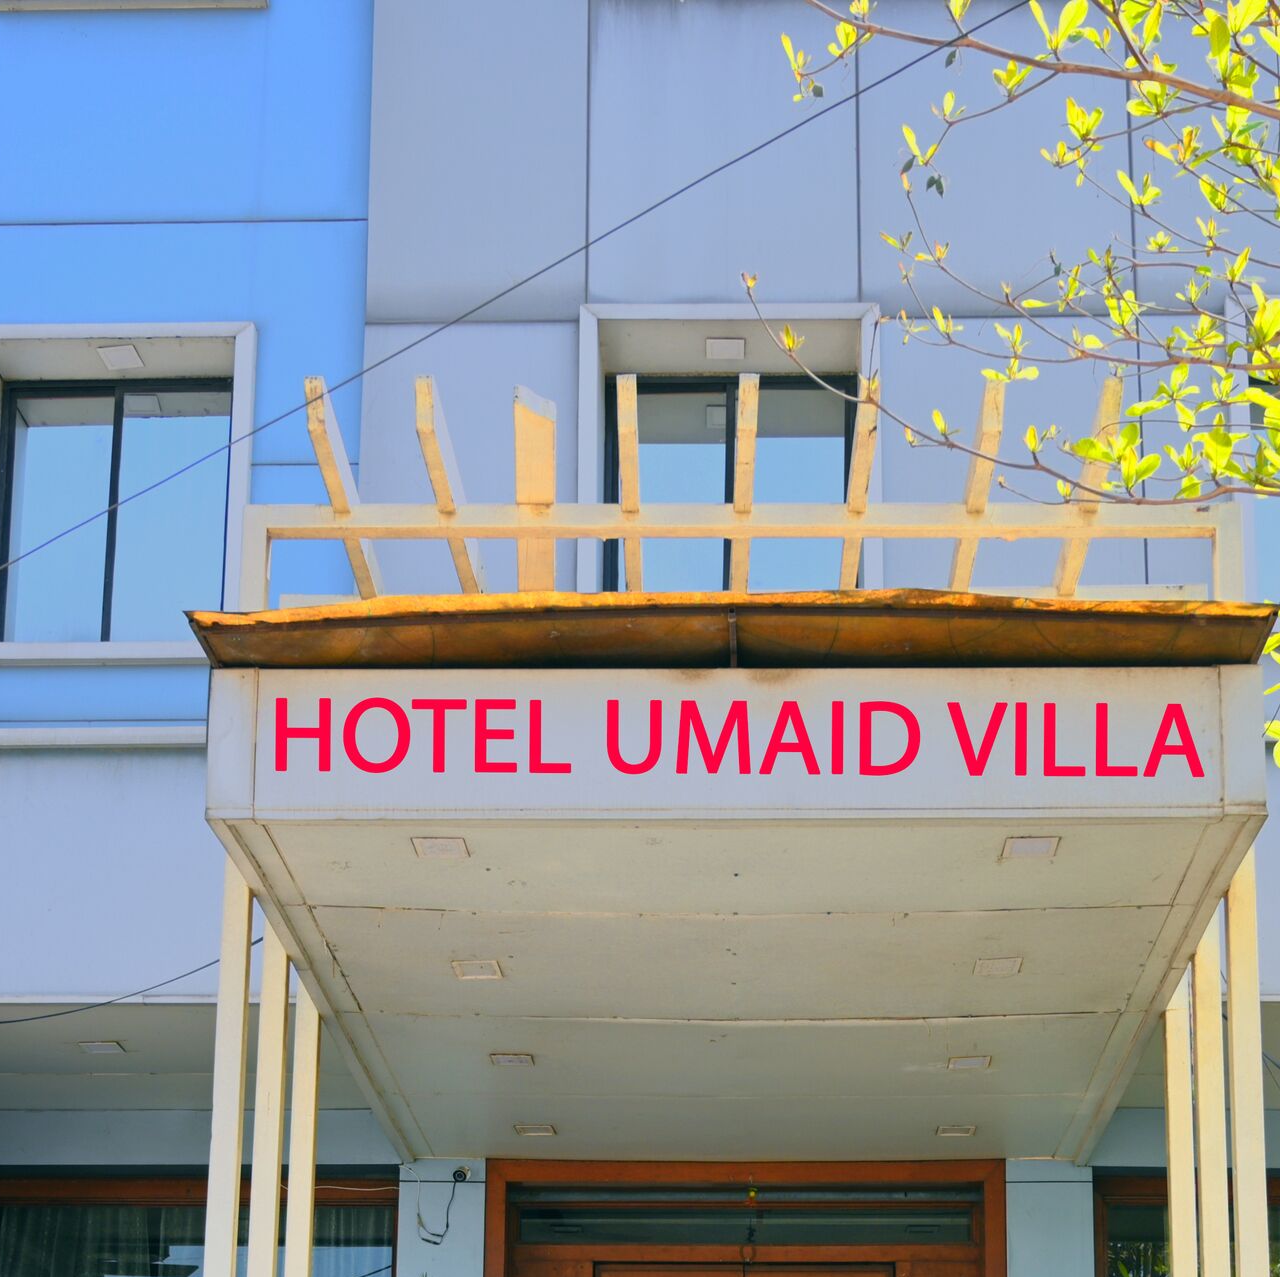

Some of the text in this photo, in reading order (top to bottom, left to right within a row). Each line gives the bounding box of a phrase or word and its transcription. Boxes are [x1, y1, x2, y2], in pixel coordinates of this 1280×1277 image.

[276, 697, 1205, 778] HOTEL UMAID VILLA
